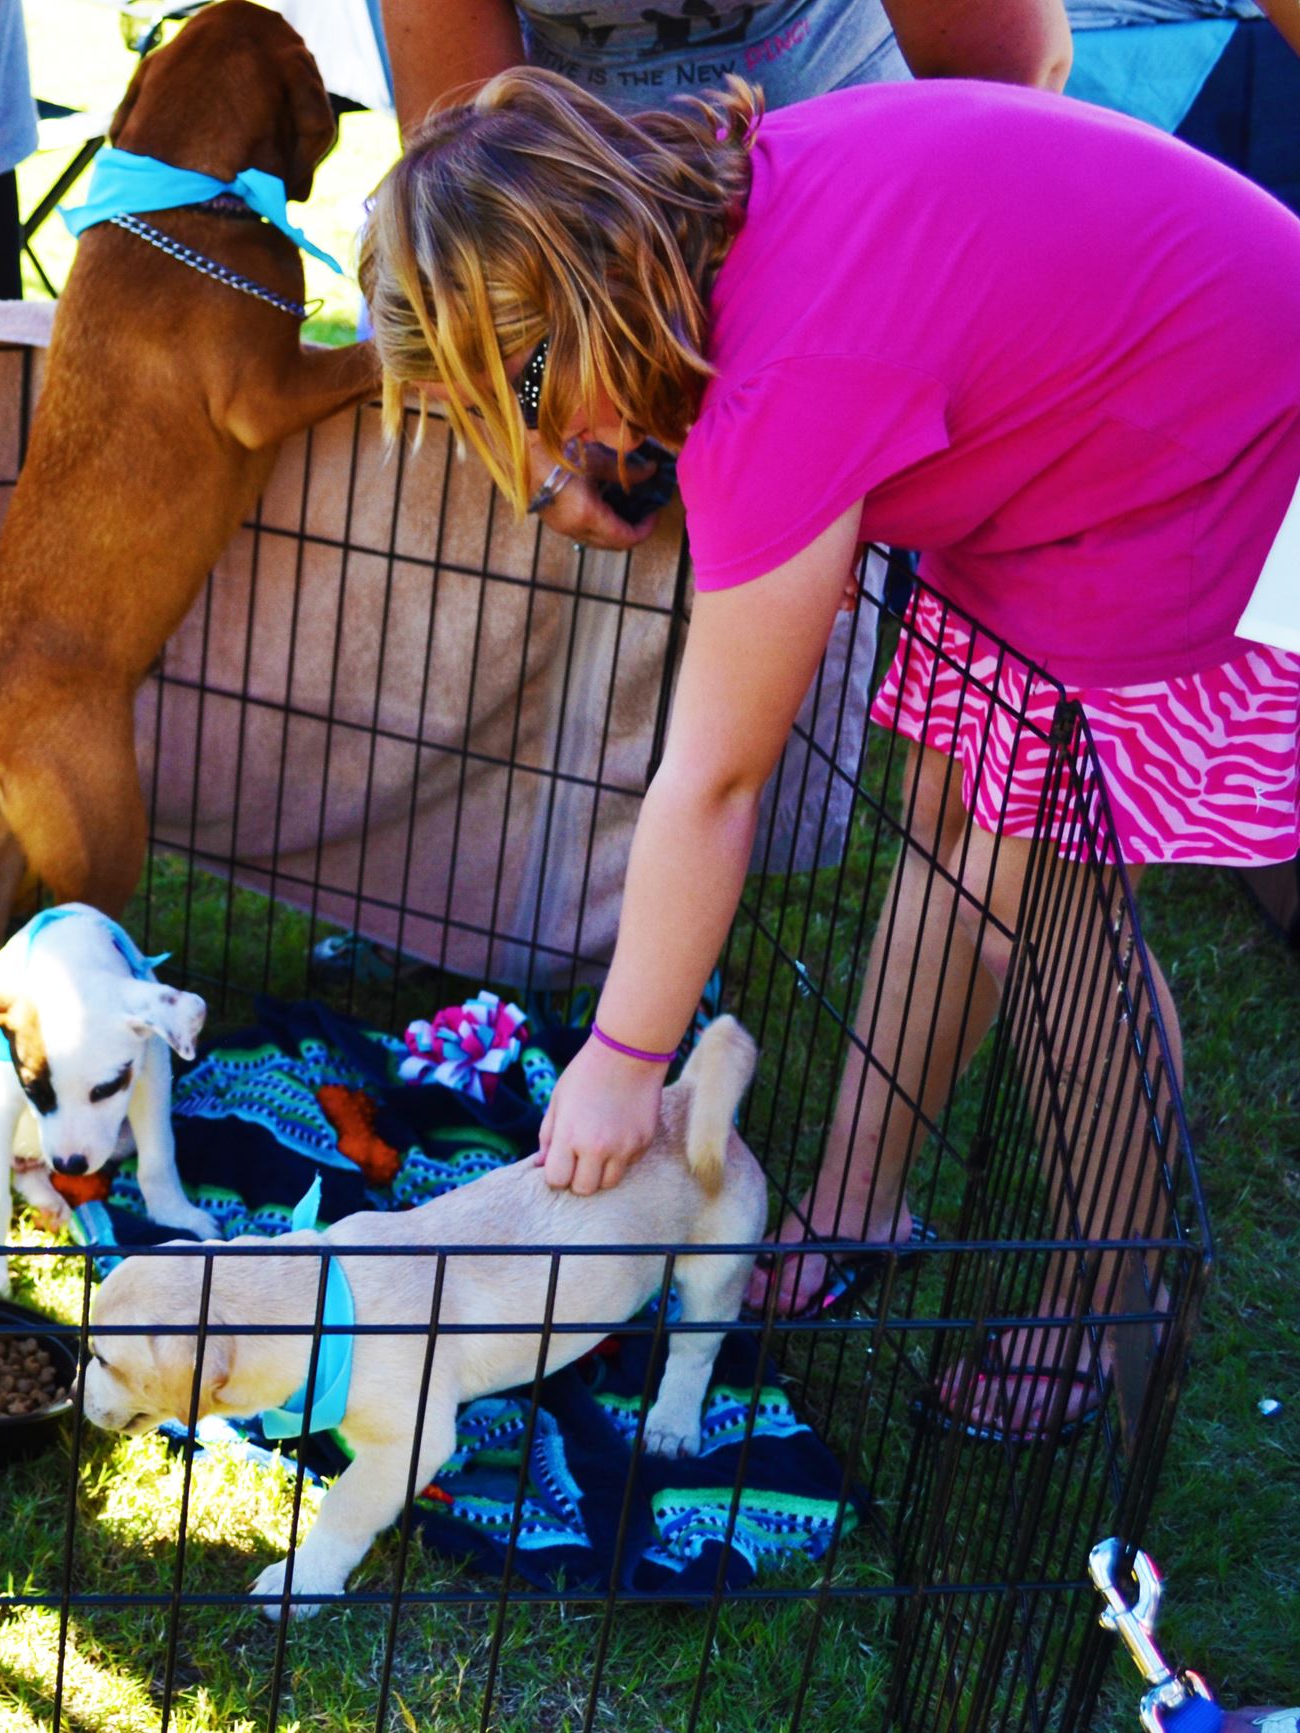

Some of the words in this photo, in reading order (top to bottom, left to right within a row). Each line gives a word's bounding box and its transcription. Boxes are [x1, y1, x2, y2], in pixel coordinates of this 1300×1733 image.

[587, 68, 607, 86] IS
[617, 70, 664, 86] THE
[675, 59, 736, 85] NEW
